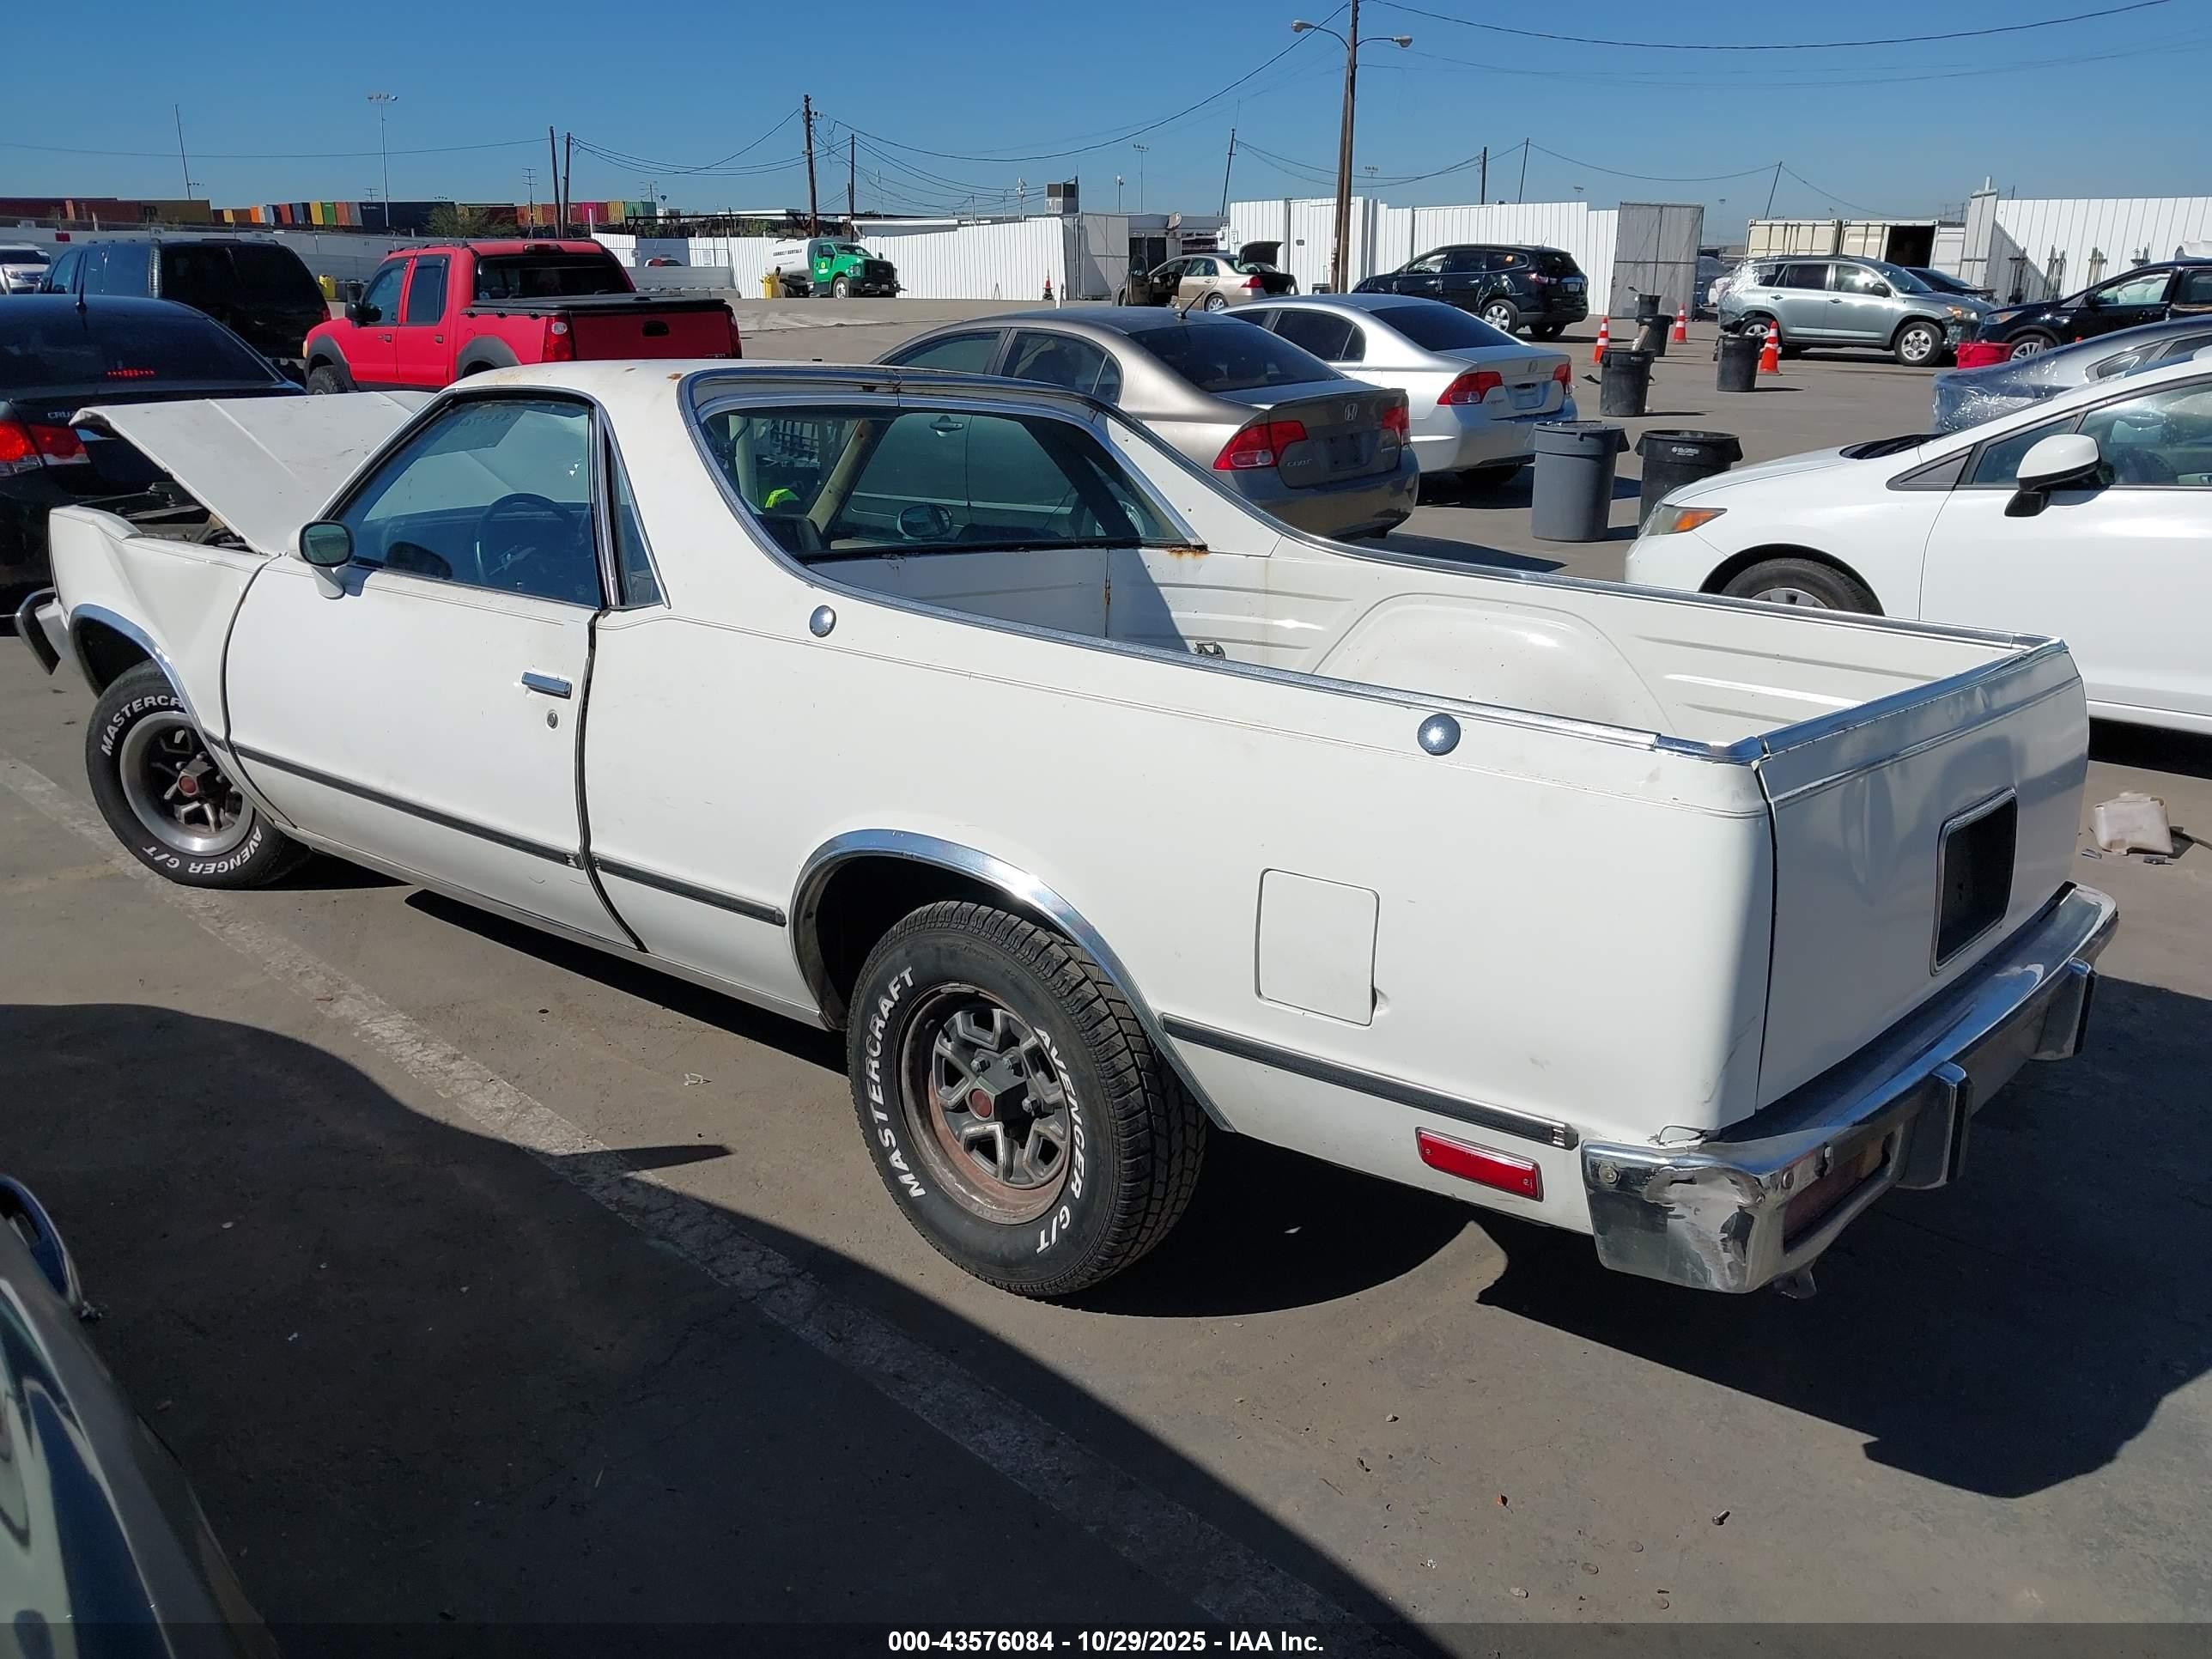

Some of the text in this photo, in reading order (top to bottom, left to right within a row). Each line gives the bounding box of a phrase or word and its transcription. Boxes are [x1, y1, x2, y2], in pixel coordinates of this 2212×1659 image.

[100, 695, 183, 757] MASTERCR
[142, 825, 264, 875] AVENGER G/T
[865, 965, 927, 1199] MASTERCRAFT
[1034, 1025, 1085, 1254] AVENGER G/T
